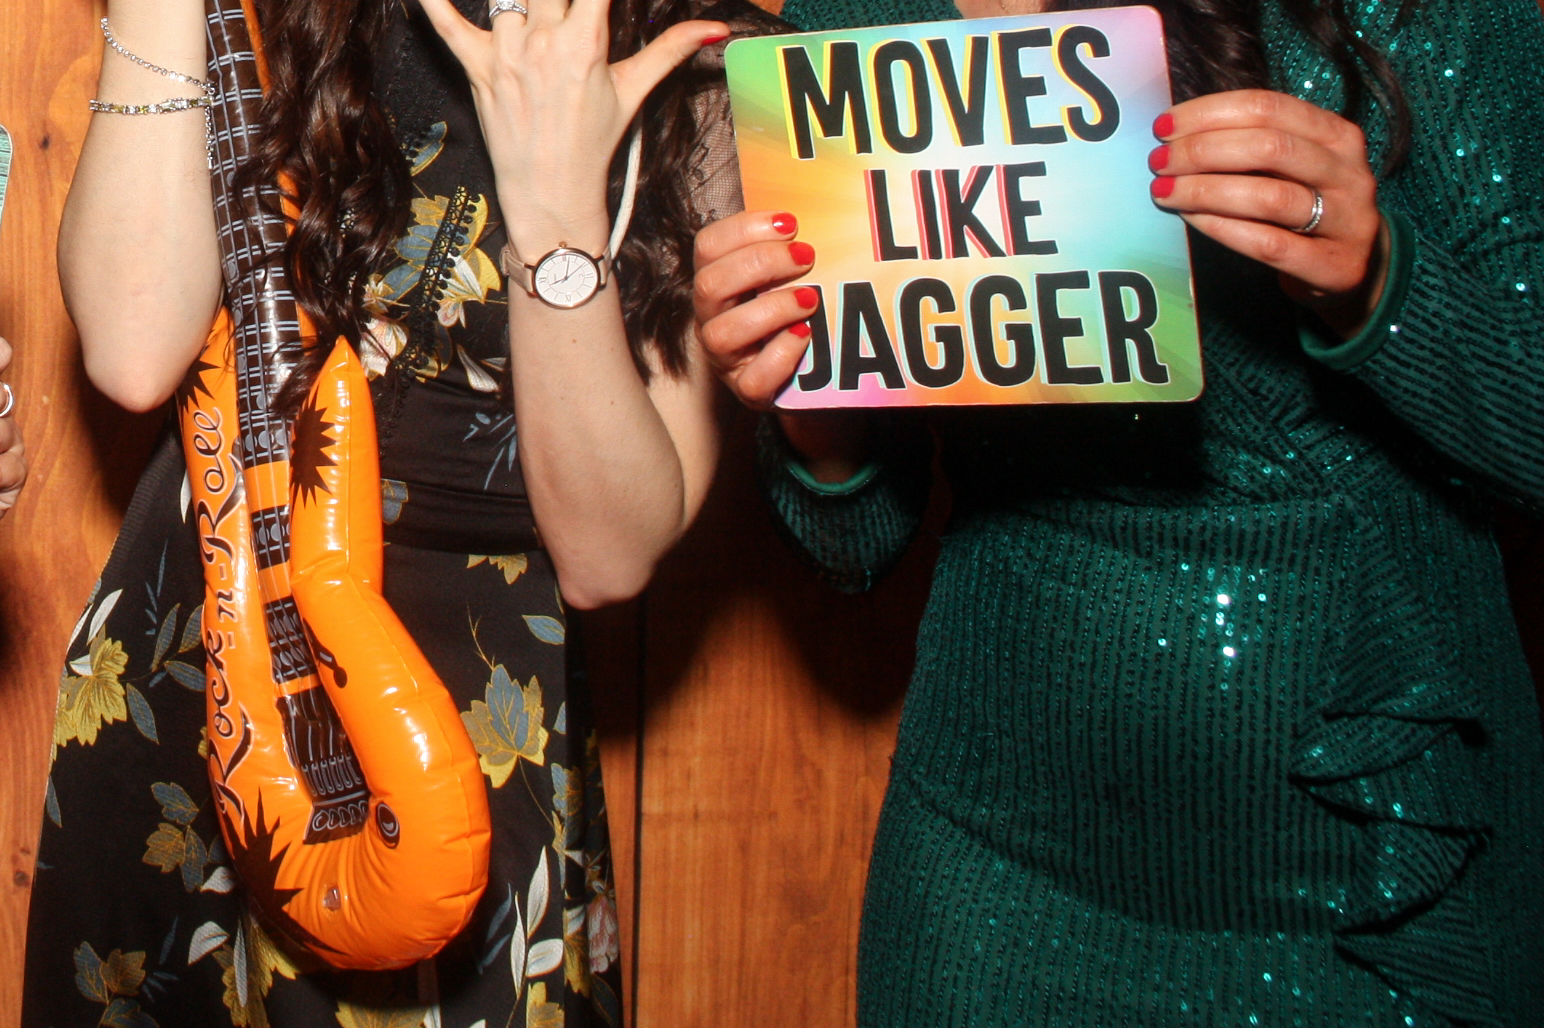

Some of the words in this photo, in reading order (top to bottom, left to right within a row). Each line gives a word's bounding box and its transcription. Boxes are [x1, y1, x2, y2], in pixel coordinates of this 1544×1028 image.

[776, 24, 1121, 160] MOVES
[864, 161, 1058, 262] LIKE
[795, 270, 1169, 392] JAGGER
